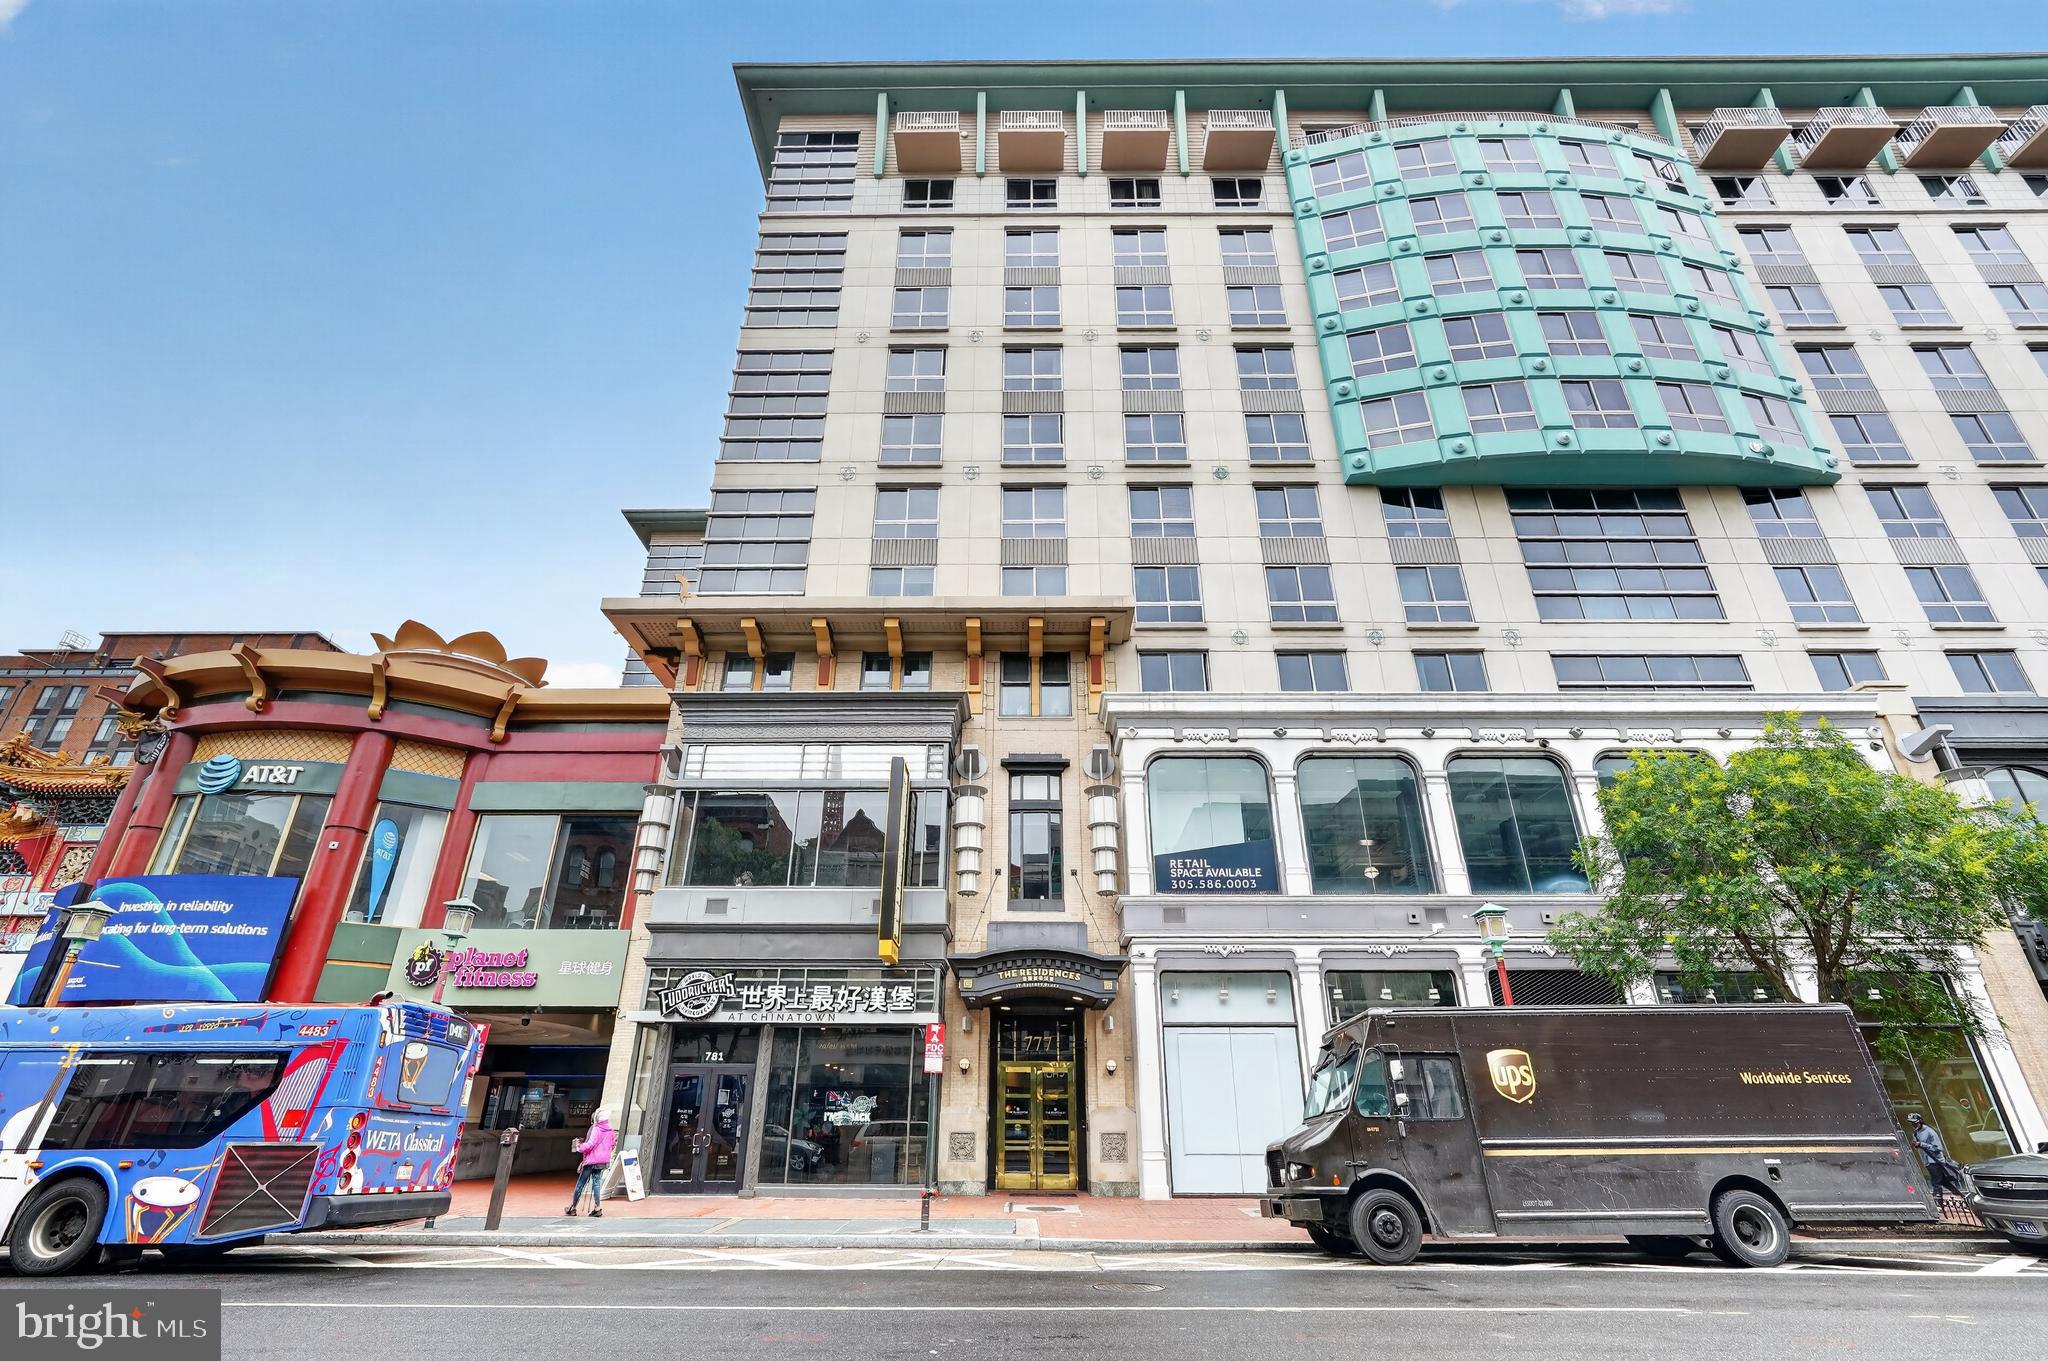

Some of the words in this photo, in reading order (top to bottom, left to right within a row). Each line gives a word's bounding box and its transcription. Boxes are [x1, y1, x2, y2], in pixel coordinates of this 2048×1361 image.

[241, 766, 304, 784] AT&T
[375, 849, 392, 861] AT&T
[1170, 859, 1211, 868] RETAIL
[1170, 868, 1204, 877] SPACE
[1205, 868, 1262, 877] AVAILABLE
[1171, 879, 1257, 889] 305.586.0003
[118, 902, 164, 914] Investing
[166, 900, 177, 911] in
[178, 900, 234, 914] reliability
[134, 922, 150, 933] for
[151, 922, 209, 935] long-term
[210, 923, 268, 935] solutions
[450, 947, 528, 969] planet
[414, 958, 435, 975] pf
[558, 960, 613, 976] 星球健身
[453, 967, 538, 987] fitness
[998, 969, 1018, 980] THE
[1020, 968, 1081, 981] RESIDENCES
[659, 973, 737, 1017] FUDDRUCKERS
[740, 985, 916, 1011] 世界上最好漢堡
[728, 1013, 744, 1021] AT
[751, 1013, 836, 1022] CHINATOWN
[299, 1025, 328, 1036] 4483
[925, 1043, 944, 1052] FDC
[1024, 1036, 1052, 1051] 777
[705, 1052, 724, 1061] 781
[368, 1056, 384, 1098] 4483
[1495, 1065, 1532, 1094] ups
[1740, 1071, 1802, 1084] Worldwide
[1803, 1071, 1852, 1084] Services
[365, 1130, 401, 1151] WETA
[404, 1132, 444, 1152] Classical
